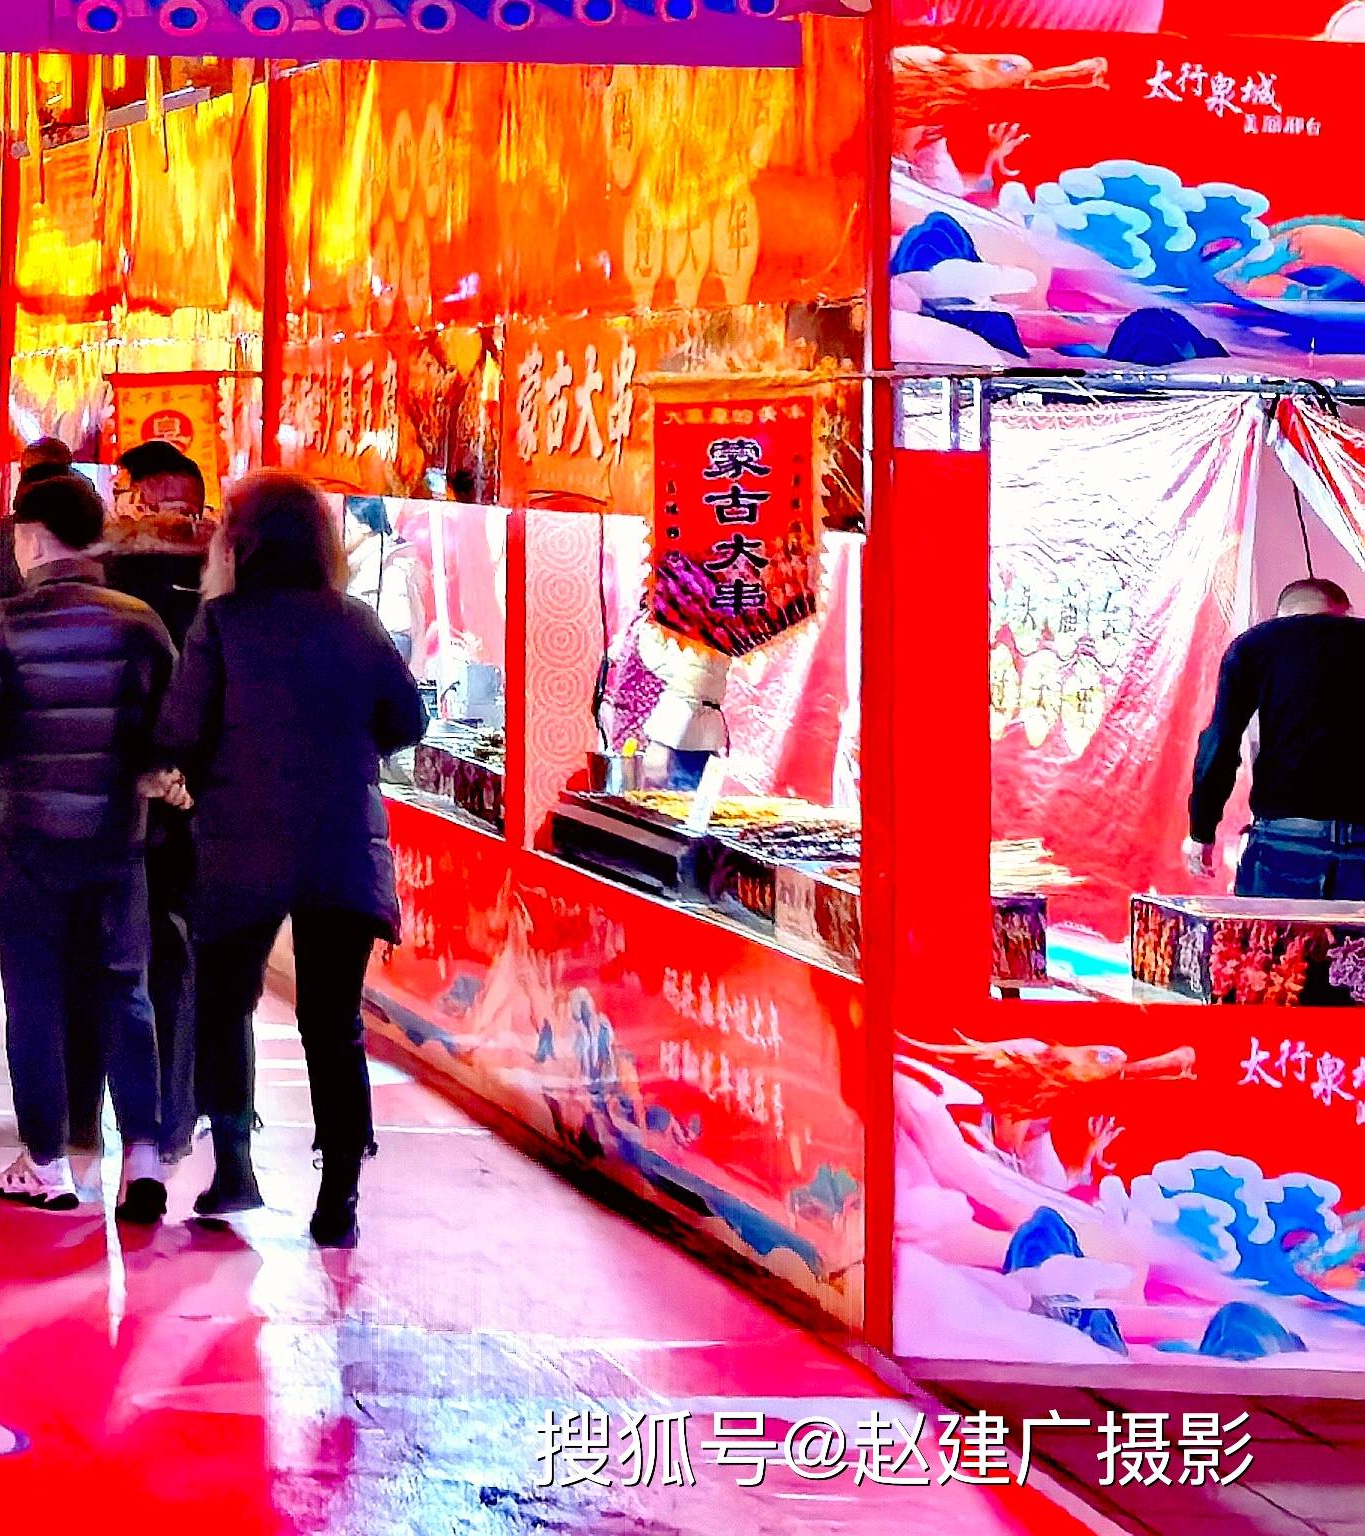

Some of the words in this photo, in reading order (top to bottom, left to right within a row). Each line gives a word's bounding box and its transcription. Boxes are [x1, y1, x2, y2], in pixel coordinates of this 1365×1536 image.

[1143, 59, 1283, 118] 太行泉城
[516, 339, 639, 465] 蒙古大串
[701, 437, 773, 618] 蒙古大串
